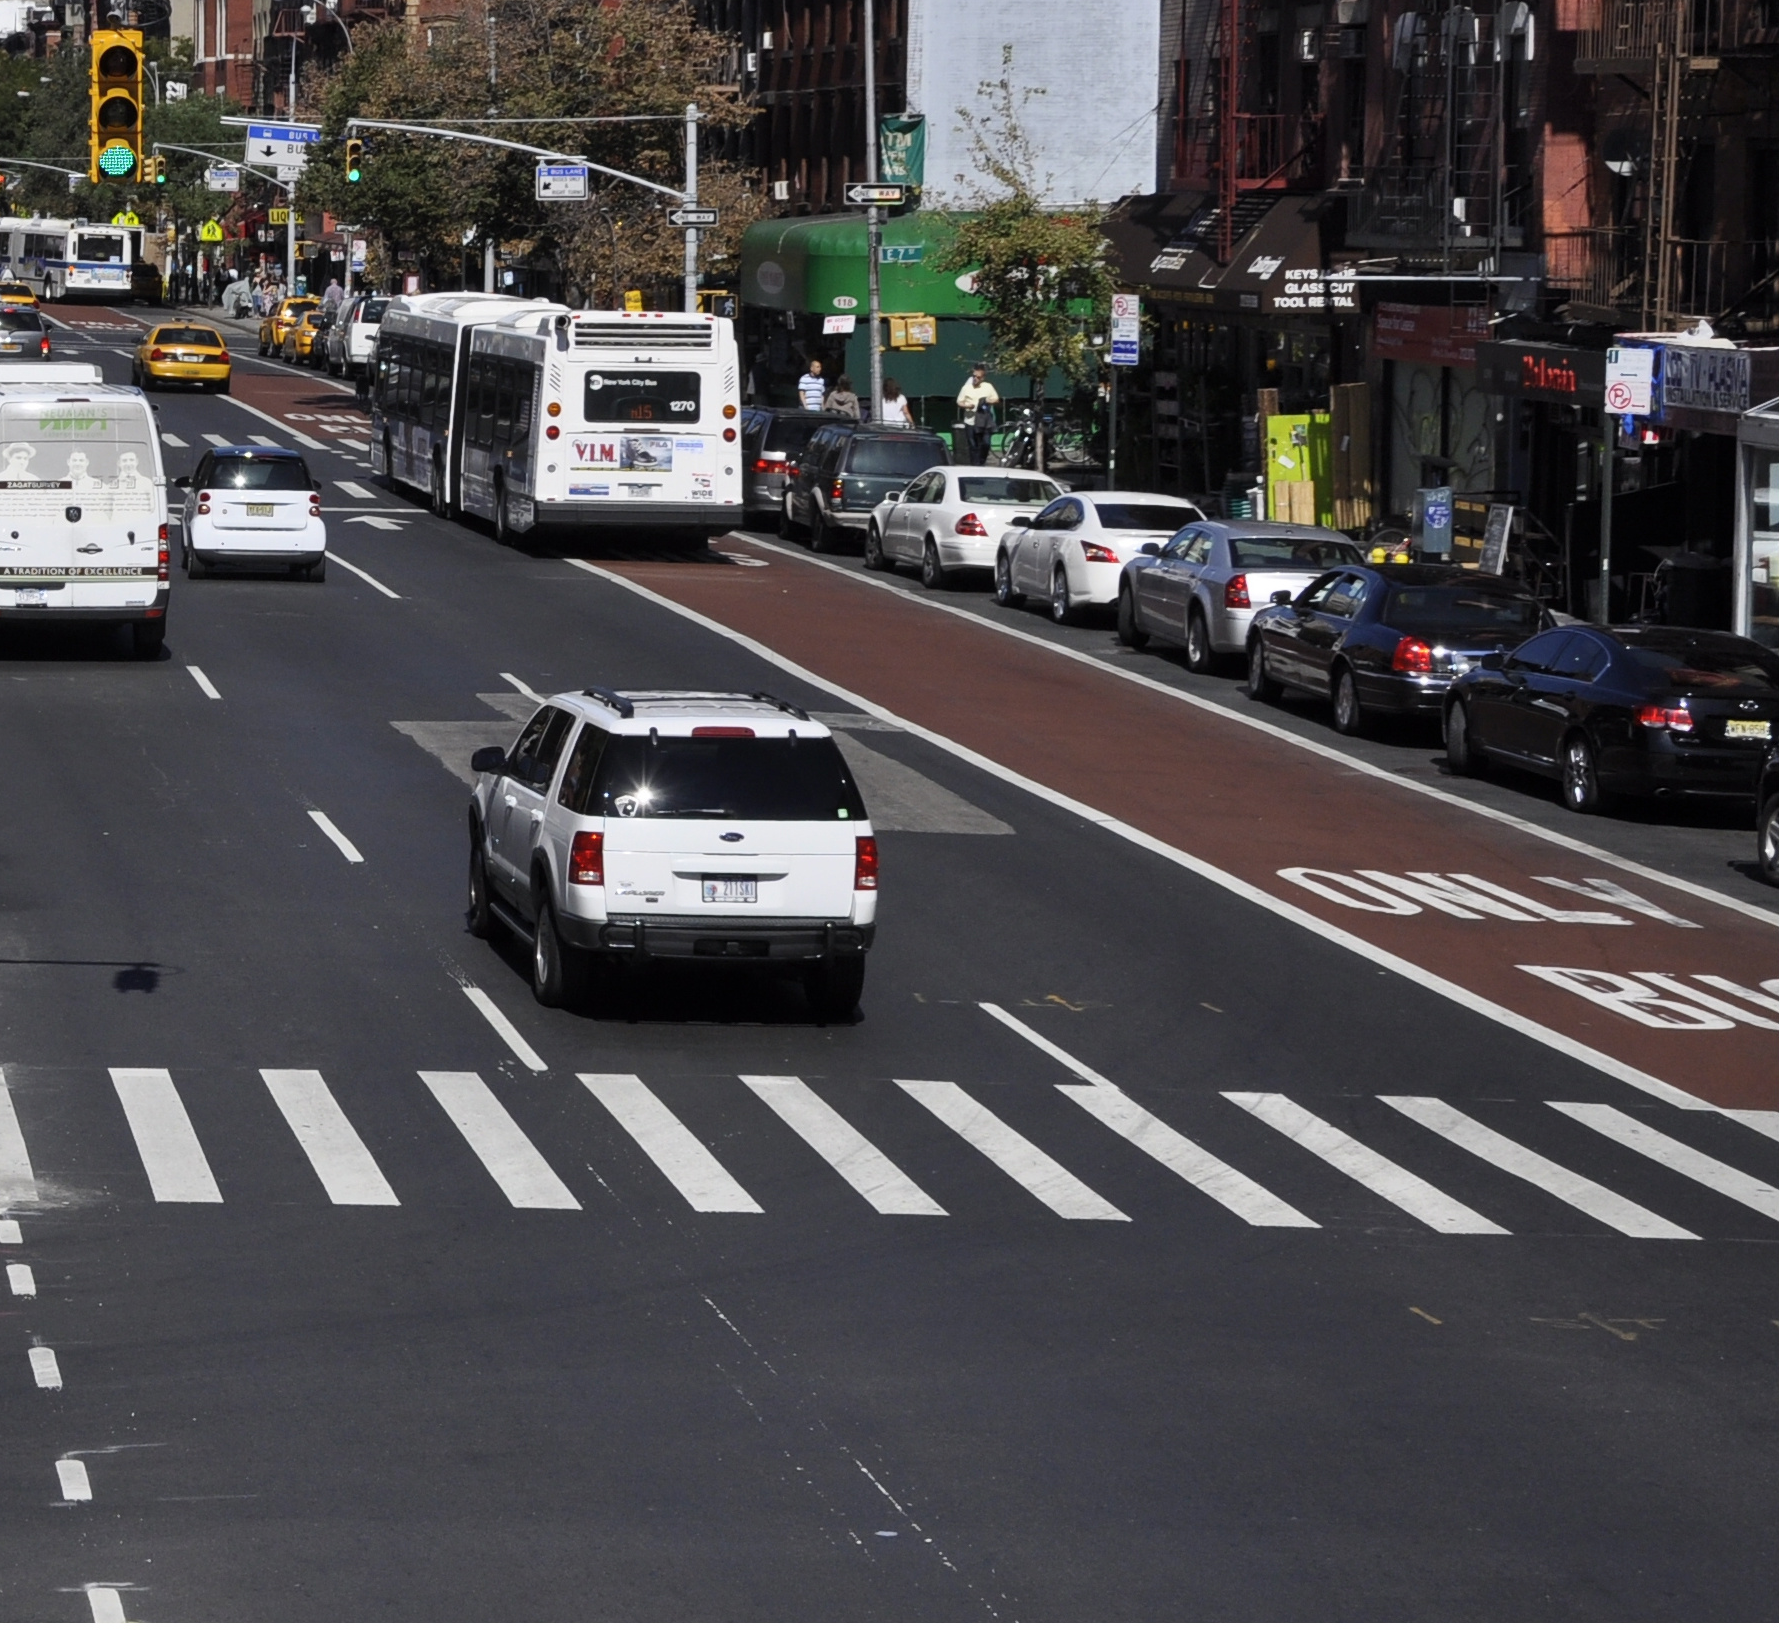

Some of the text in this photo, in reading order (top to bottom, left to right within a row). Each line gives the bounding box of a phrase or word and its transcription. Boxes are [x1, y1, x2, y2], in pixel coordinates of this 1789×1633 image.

[854, 189, 896, 198] ONE WAY
[271, 210, 304, 223] LIQO
[898, 249, 905, 260] 7
[1285, 269, 1318, 280] KEYS
[1284, 283, 1354, 294] GLASS CUT
[837, 298, 853, 307] 118
[1273, 296, 1354, 309] TOOL RENTAL
[670, 401, 695, 411] 1270
[284, 413, 373, 424] ONL
[84, 568, 143, 576] EXCELLENCE
[1275, 866, 1704, 929] ONLY
[1514, 964, 1779, 1030] BU
